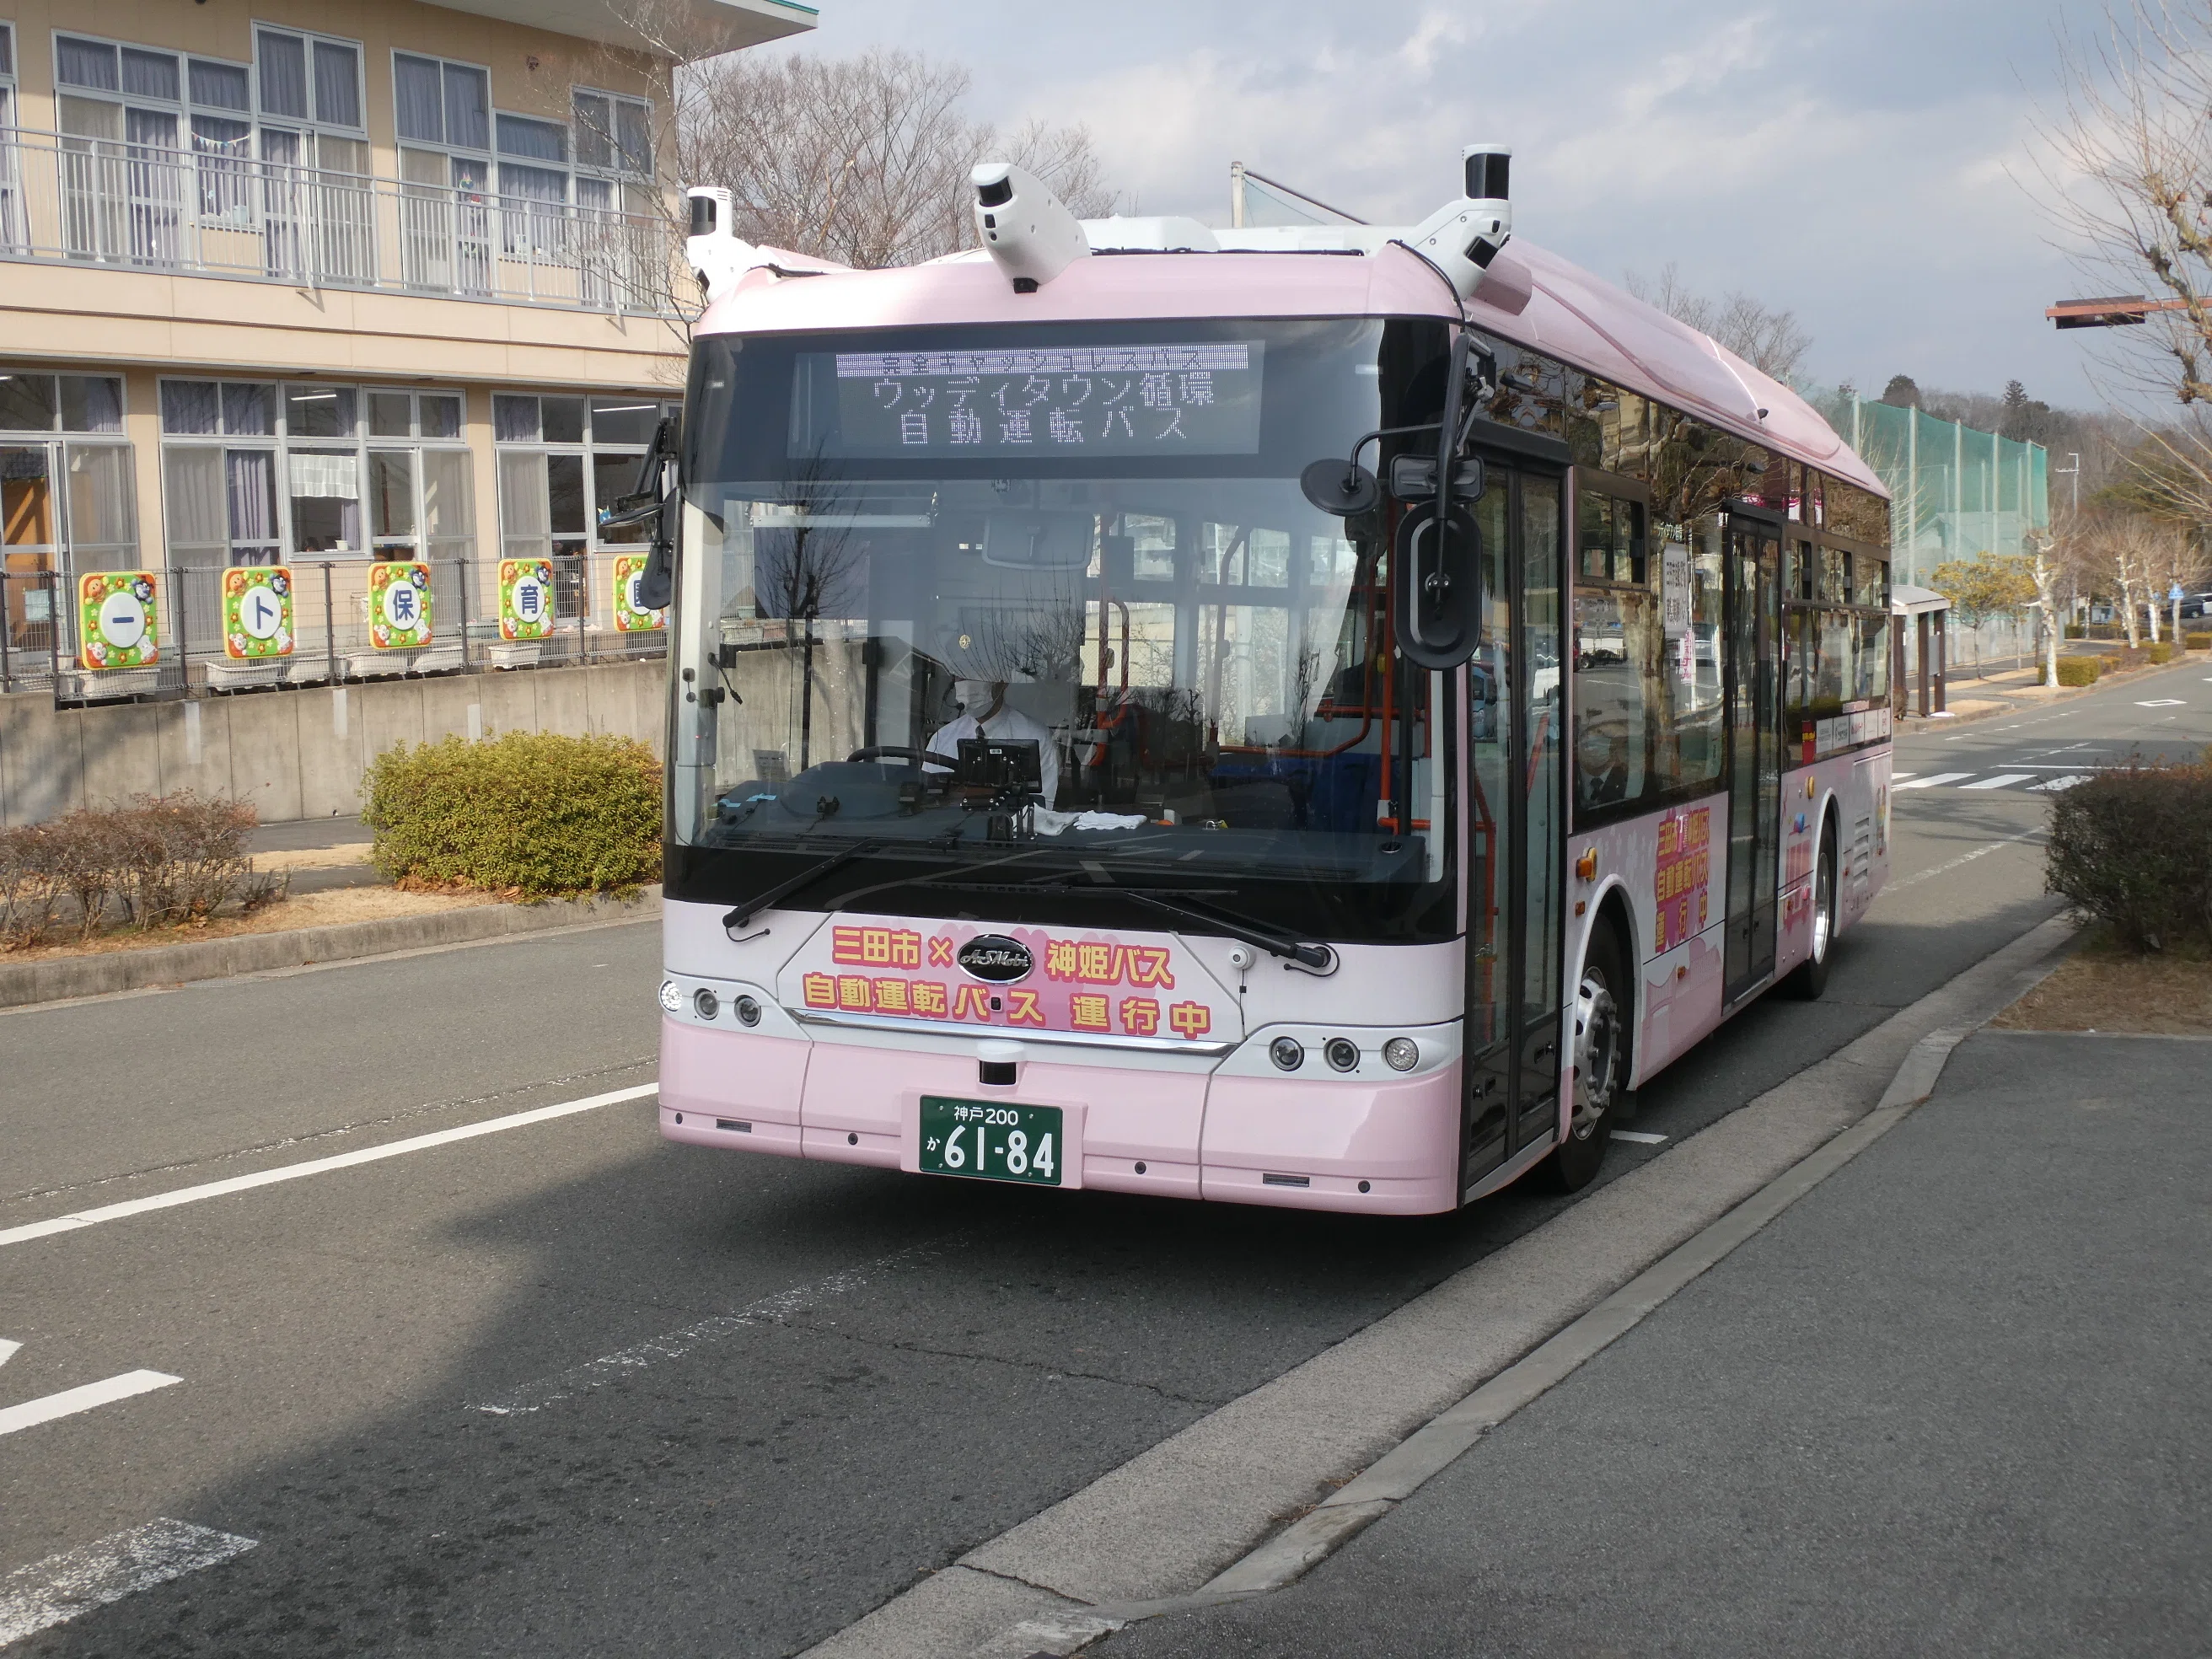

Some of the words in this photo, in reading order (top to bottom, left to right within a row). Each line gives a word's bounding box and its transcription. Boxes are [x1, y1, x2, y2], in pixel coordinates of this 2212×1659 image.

[882, 346, 1203, 375] 完全キャッシュレスバス
[873, 371, 1215, 409] ウッディタウン循環
[899, 405, 1187, 445] 自動運転バス
[1656, 851, 1708, 903] 自動運転バス
[1046, 940, 1173, 987] 神姫バス
[804, 973, 1044, 1022] 自動運転バス
[1071, 995, 1210, 1037] 運行中
[943, 1124, 1055, 1179] 61-84
